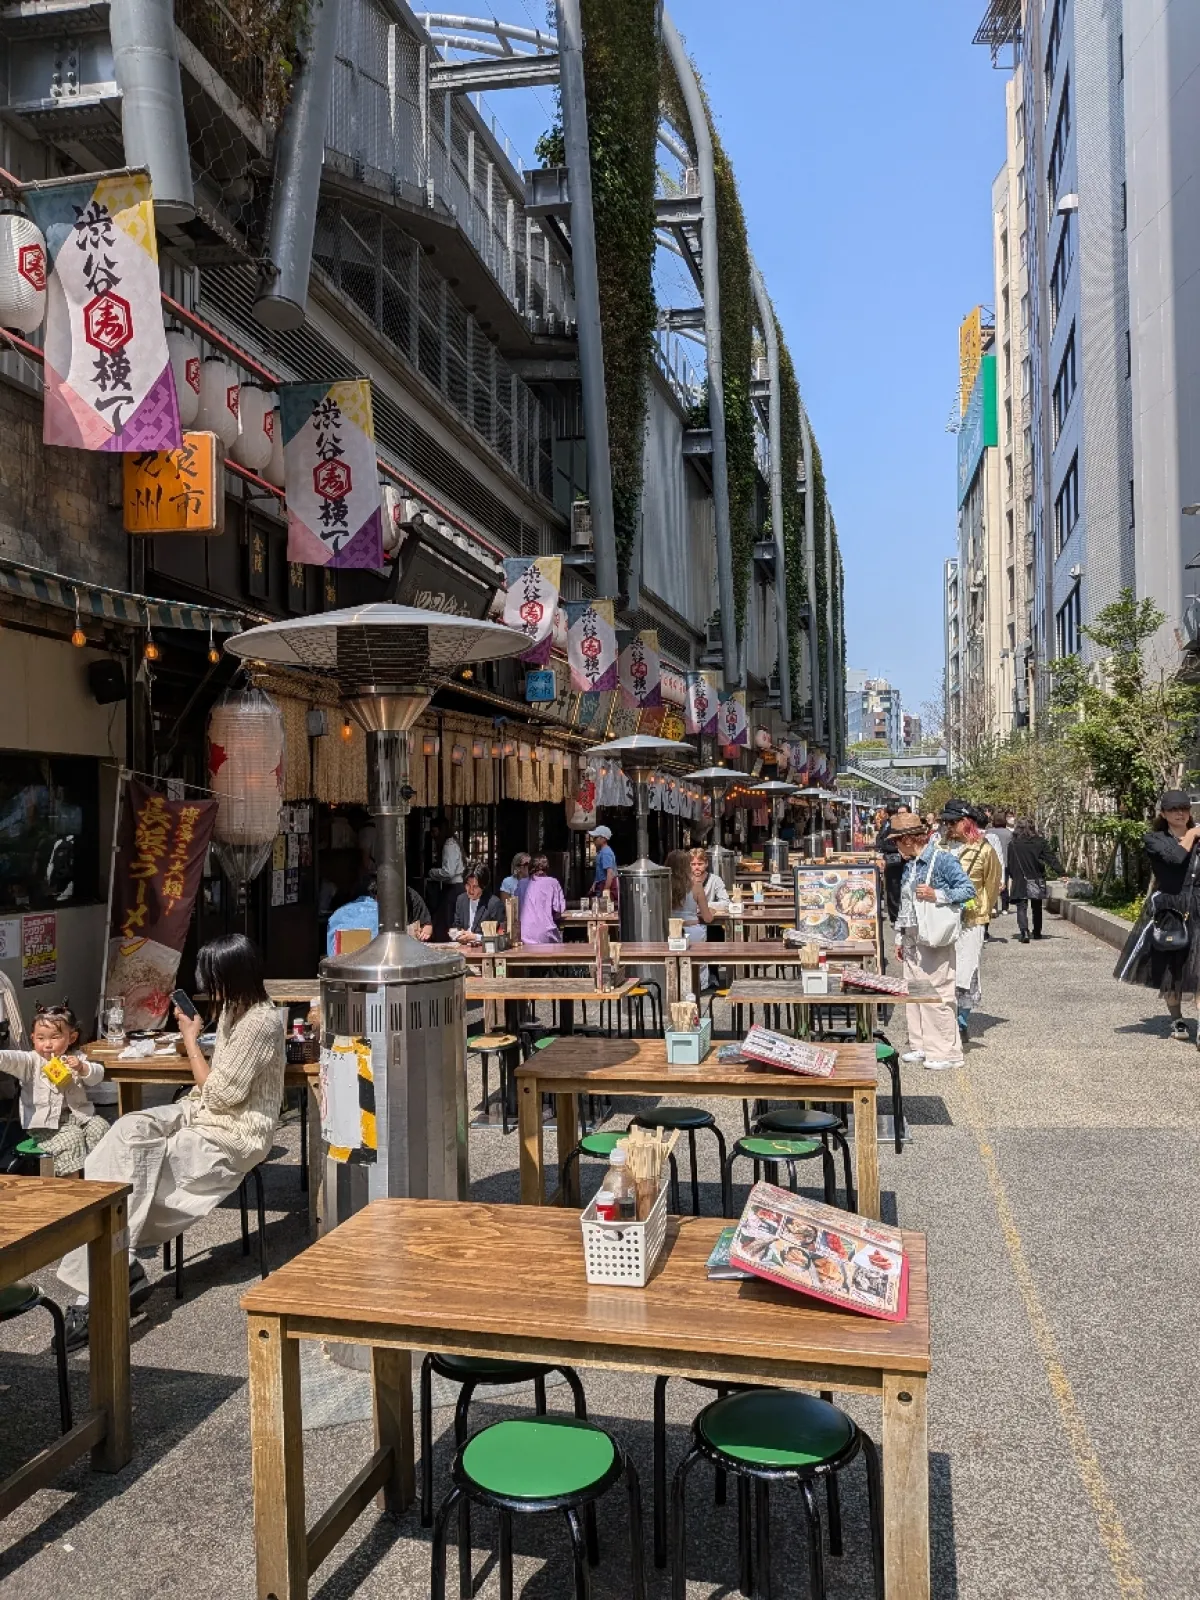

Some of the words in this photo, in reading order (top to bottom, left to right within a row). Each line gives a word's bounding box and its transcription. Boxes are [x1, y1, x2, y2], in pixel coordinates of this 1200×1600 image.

[119, 796, 172, 957] 長浜ラーメン
